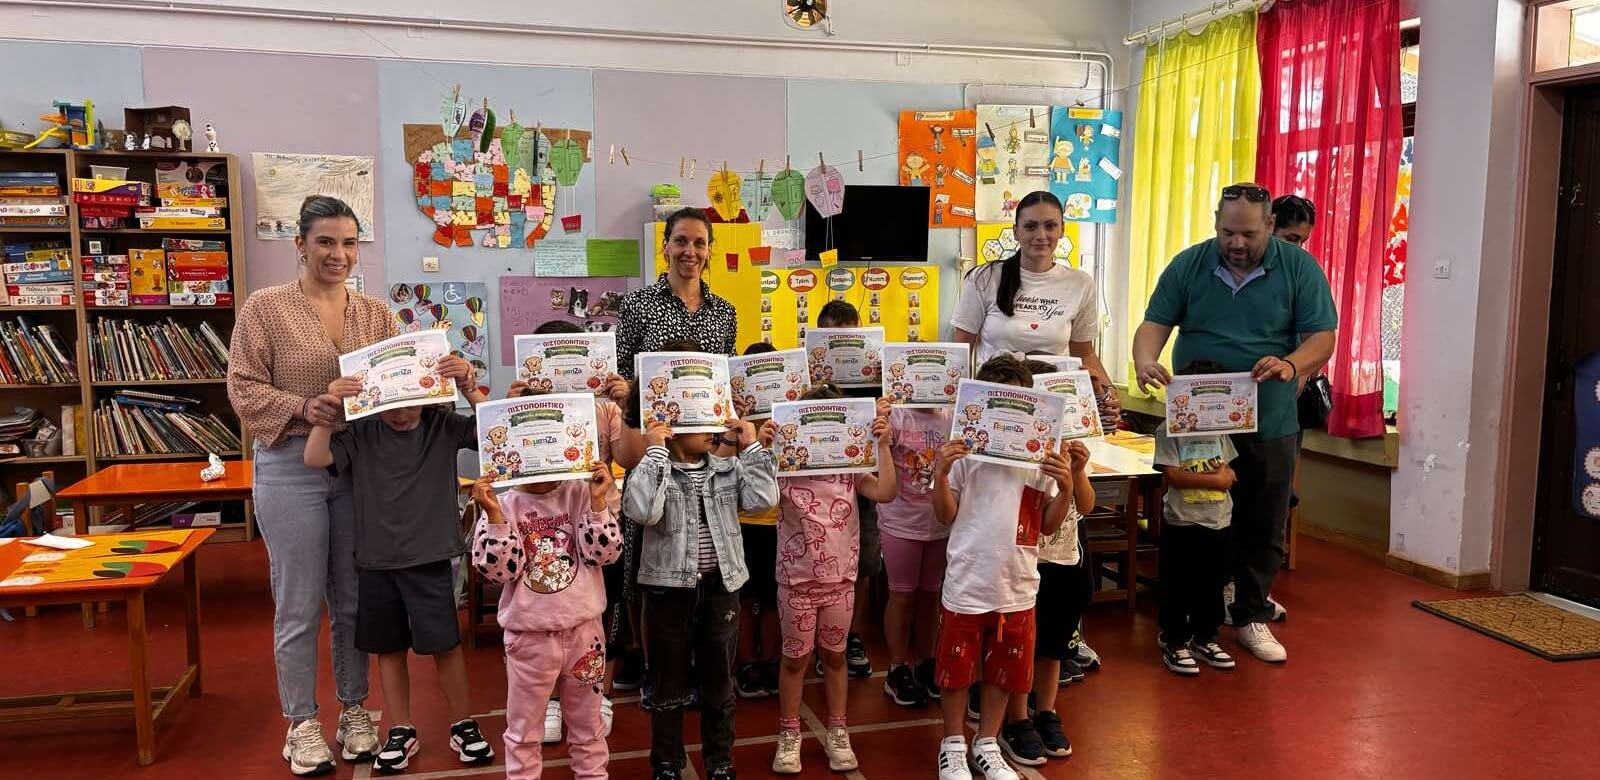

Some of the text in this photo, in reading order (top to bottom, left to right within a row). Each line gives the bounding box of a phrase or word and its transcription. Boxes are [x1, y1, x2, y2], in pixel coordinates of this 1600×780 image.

[1016, 293, 1039, 304] hoose
[1041, 305, 1064, 320] You
[507, 402, 564, 414] ΠΙΣΤΟΠΟΙΗΤΙΚΟ
